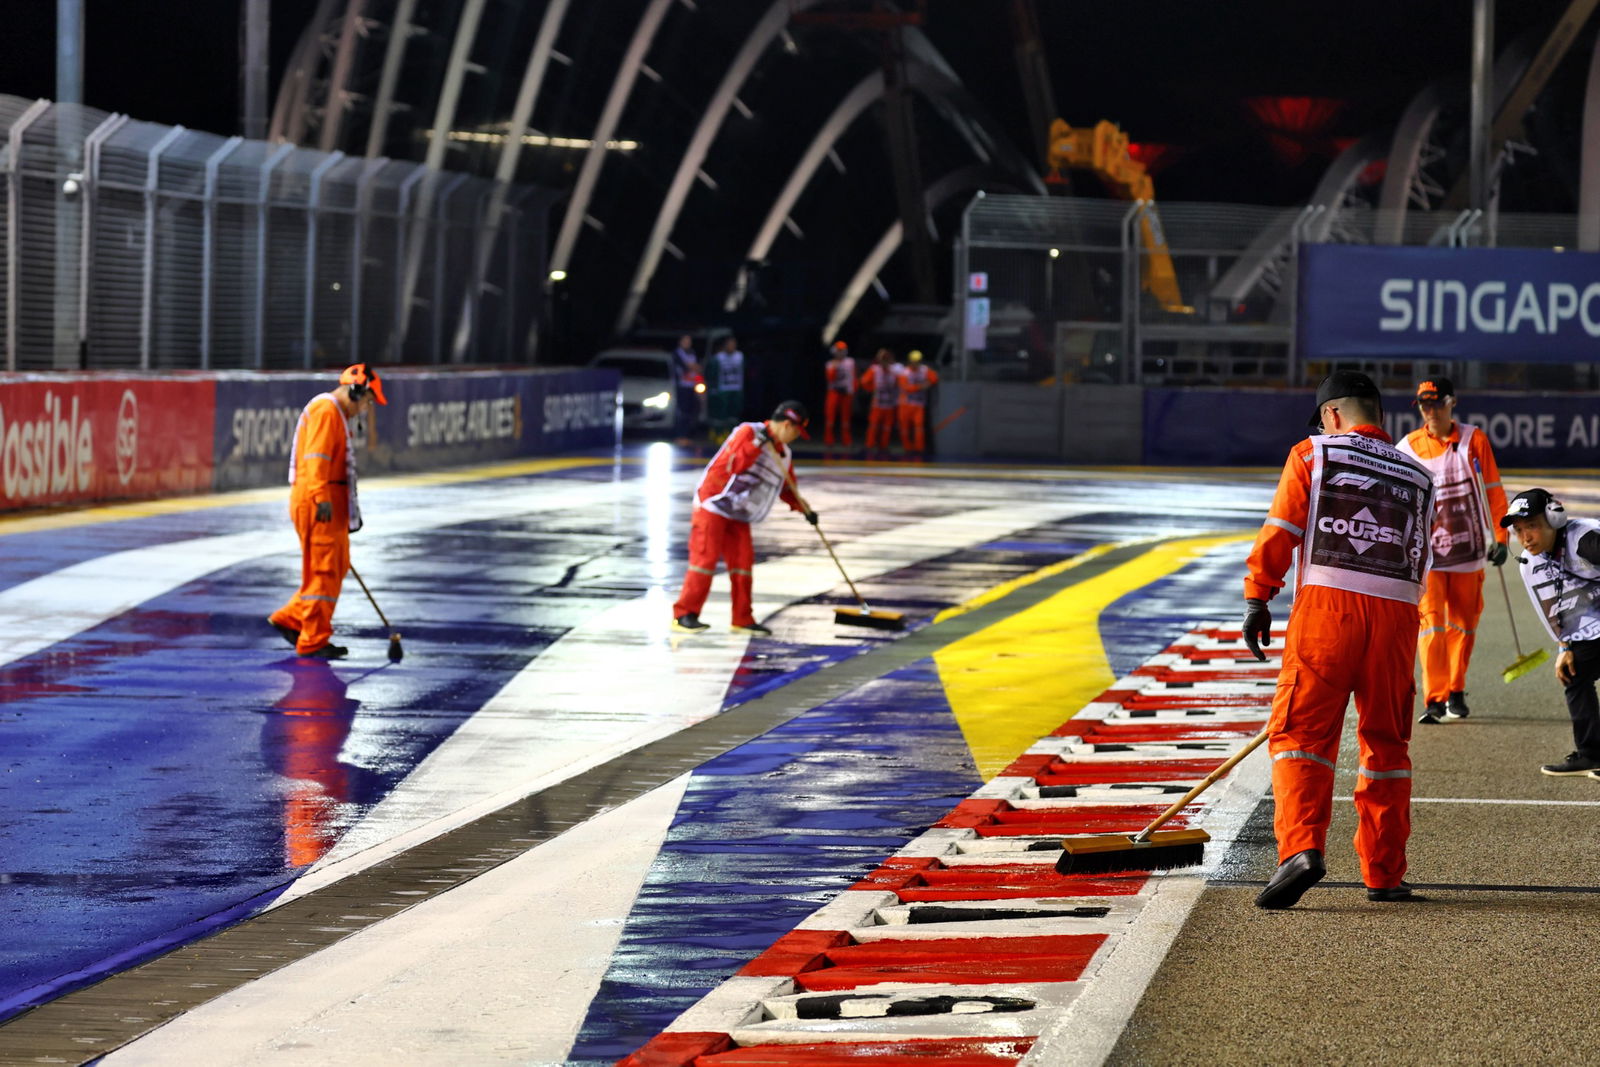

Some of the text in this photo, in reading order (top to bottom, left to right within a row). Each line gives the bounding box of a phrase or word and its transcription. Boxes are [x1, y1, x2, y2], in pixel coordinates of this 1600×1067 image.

[1348, 453, 1414, 479] INTERVENTION MARSHAL
[1391, 486, 1410, 501] FIA
[1318, 516, 1403, 546] COURSE
